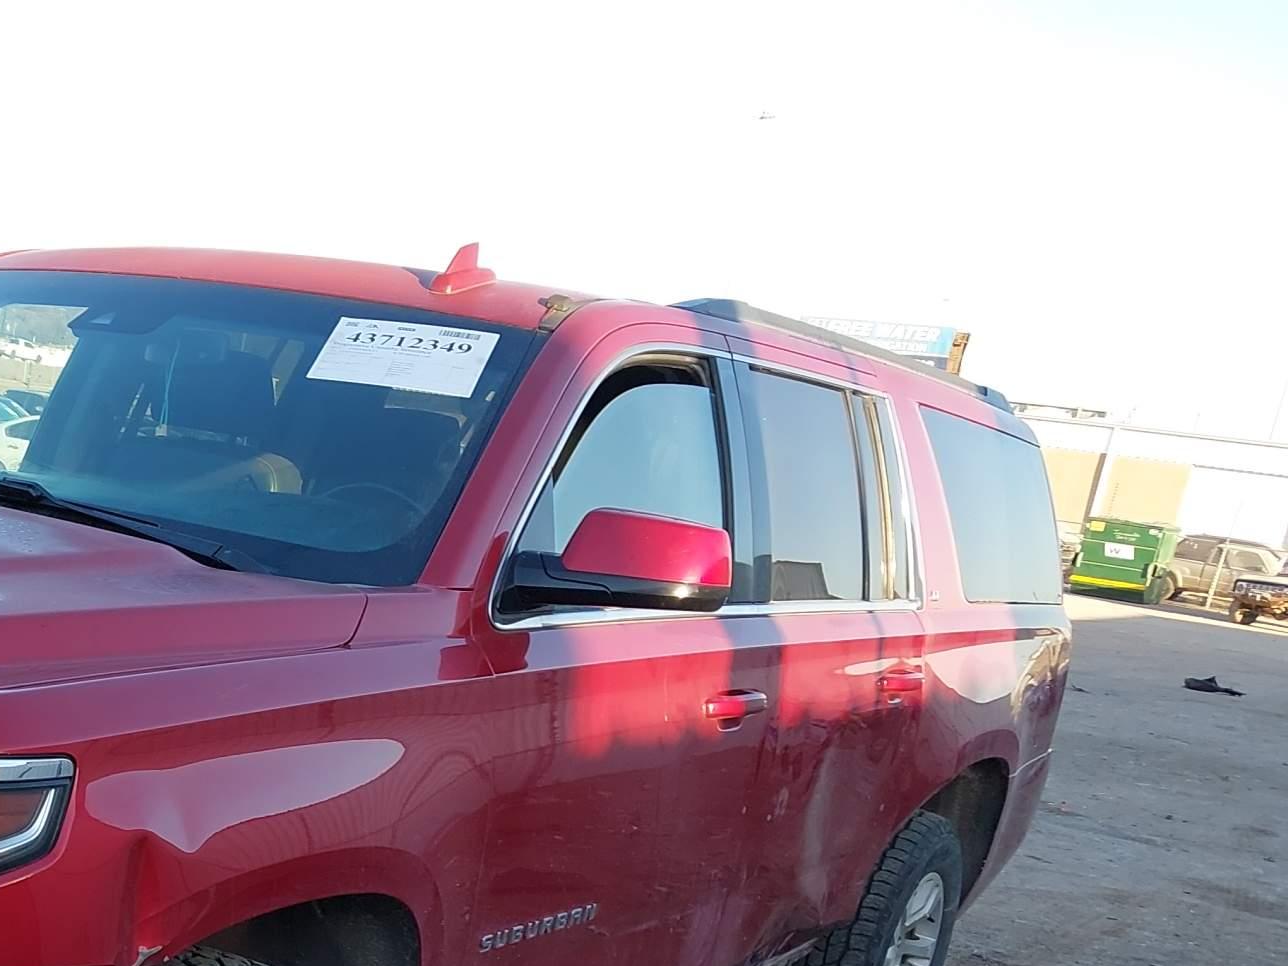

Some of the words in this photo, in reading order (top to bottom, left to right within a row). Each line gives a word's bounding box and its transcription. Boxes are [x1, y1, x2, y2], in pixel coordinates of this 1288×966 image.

[826, 319, 874, 337] FREE
[874, 322, 940, 342] WATER
[345, 331, 473, 355] 43712349
[479, 903, 599, 953] SUBURBAN
